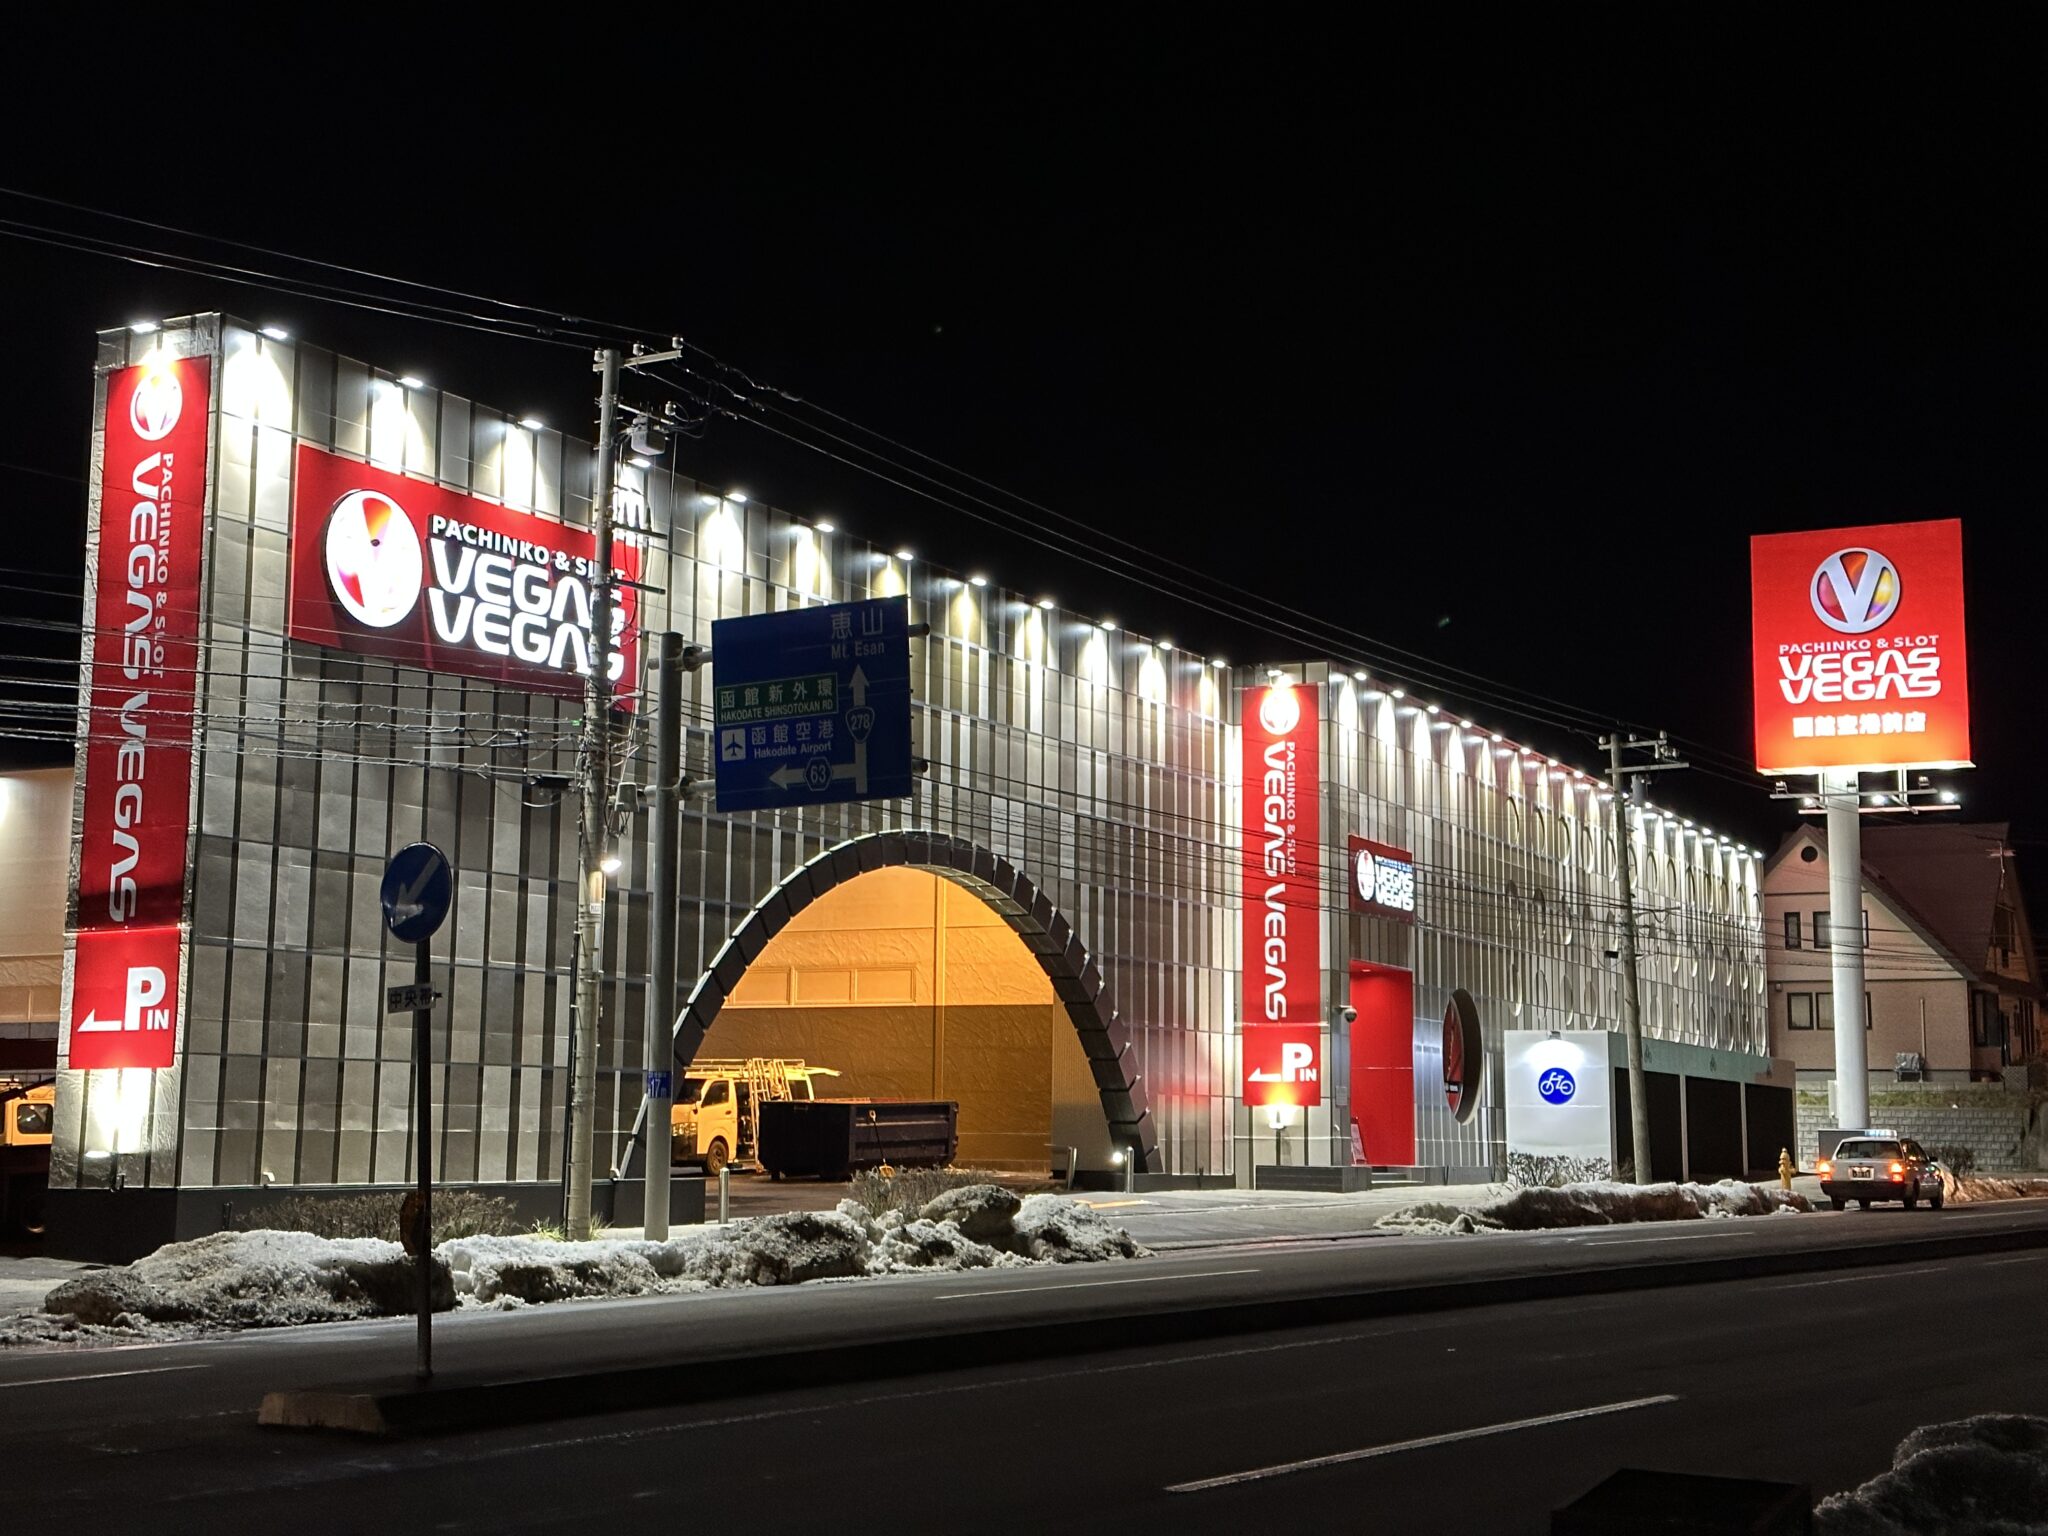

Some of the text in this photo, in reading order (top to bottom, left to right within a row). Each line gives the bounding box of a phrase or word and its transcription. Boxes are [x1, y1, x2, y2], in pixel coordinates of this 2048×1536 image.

[432, 514, 626, 580] PACHINKO & SLT
[153, 453, 174, 678] PACHINKO & SLOT
[830, 607, 884, 640] 恵山
[854, 640, 885, 657] Esan
[1779, 635, 1939, 655] PACHINKO & SLOT
[1778, 647, 1941, 681] VEGAS
[109, 452, 160, 923] VEGAS VEGAS
[721, 678, 833, 709] 函館新外環
[1778, 672, 1942, 704] VEGAS
[720, 699, 833, 723] HAKODATE SHINSOTOKAN RD
[850, 713, 871, 731] 278
[752, 719, 834, 745] 函館空港
[753, 741, 832, 759] Hakodate Airport
[809, 765, 826, 784] 63
[1286, 742, 1297, 877] PACHINKO & SLOT
[1264, 740, 1287, 1021] VEGAS VEGAS
